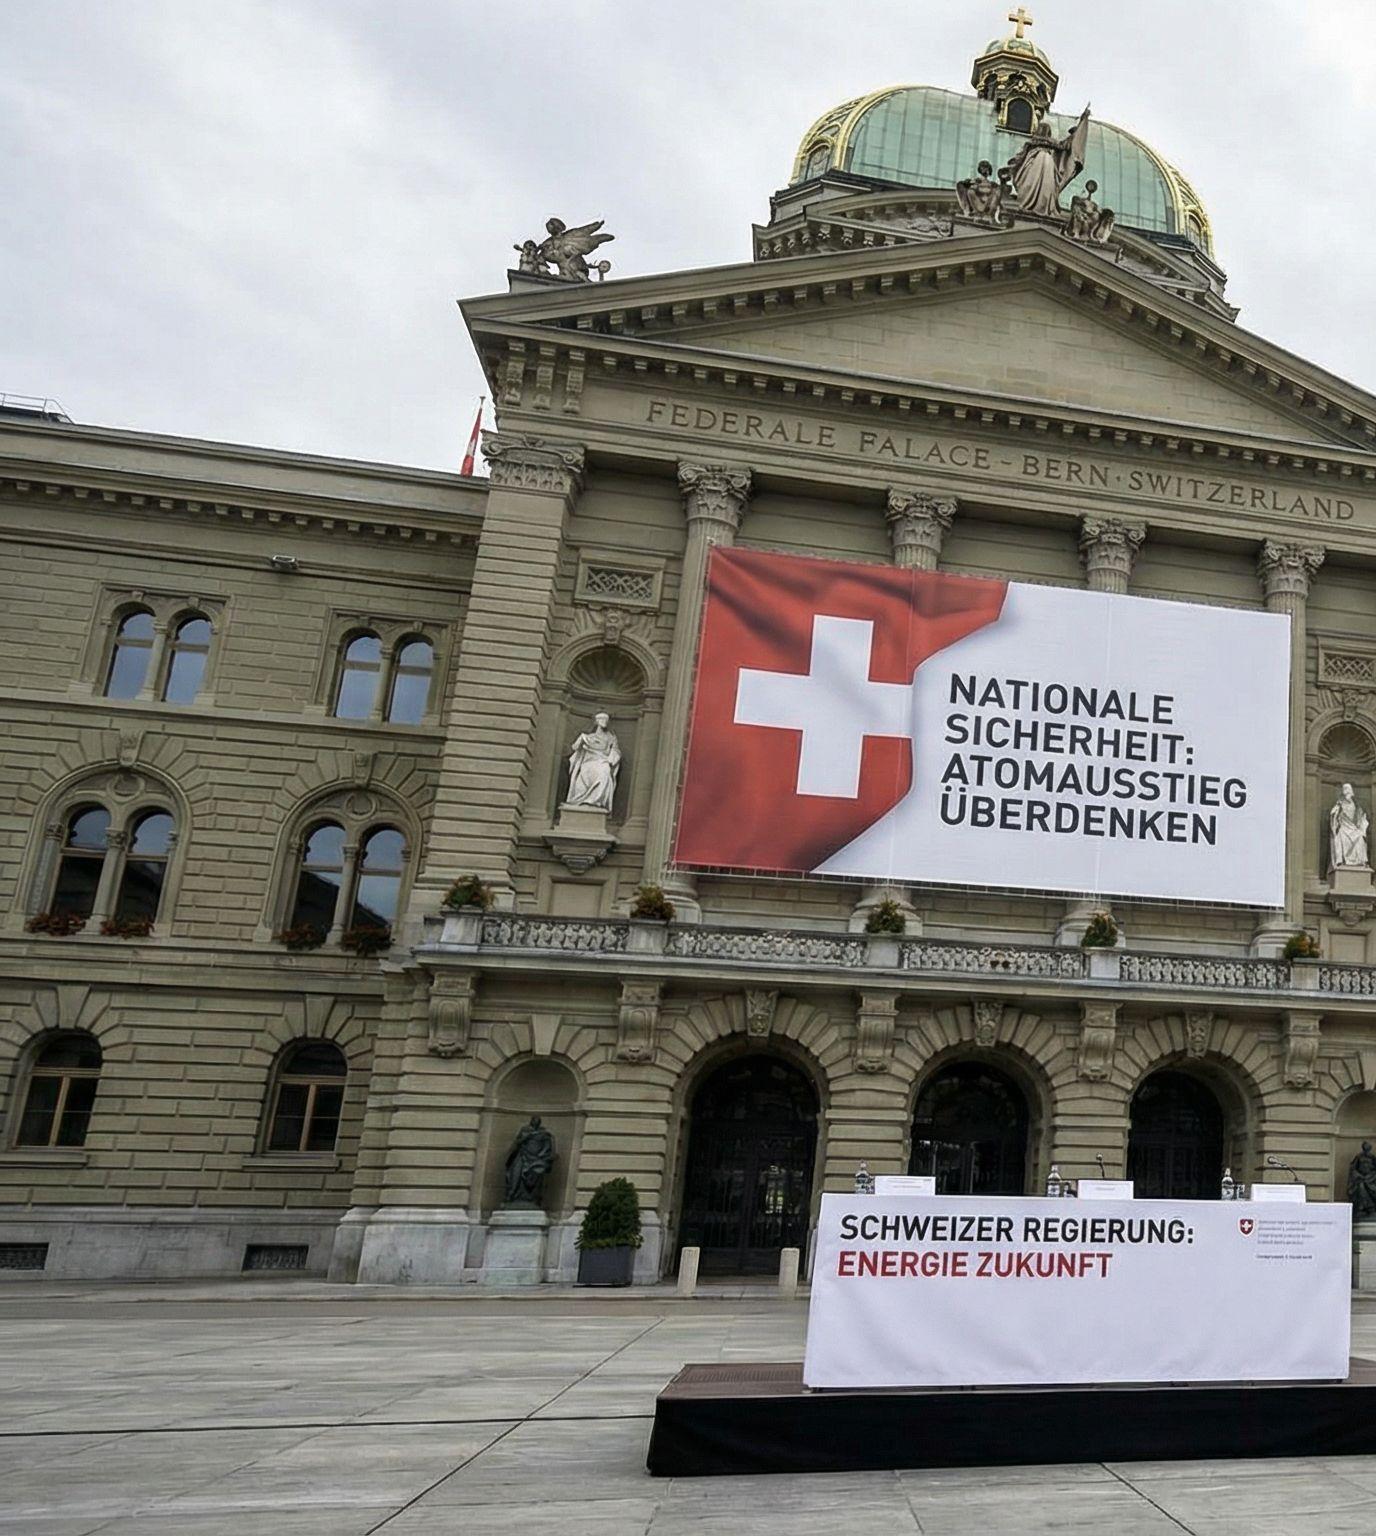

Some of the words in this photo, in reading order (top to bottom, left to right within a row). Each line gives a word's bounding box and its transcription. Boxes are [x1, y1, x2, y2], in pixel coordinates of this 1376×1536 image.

[646, 400, 836, 448] FEDERALE
[1022, 454, 1110, 487] BERN
[1128, 470, 1355, 521] SWITZERLAND
[949, 672, 1175, 725] NATIONALE
[944, 713, 1194, 766] SICHERHEIT:
[940, 753, 1248, 809] ATOMAUSSTIEG
[939, 785, 1218, 846] ÜBERDENKEN
[840, 1215, 1014, 1243] SCHWEIZER
[1023, 1217, 1194, 1244] REGIERUNG:
[837, 1250, 968, 1278] ENERGIE
[975, 1251, 1114, 1278] ZUKUNFT
